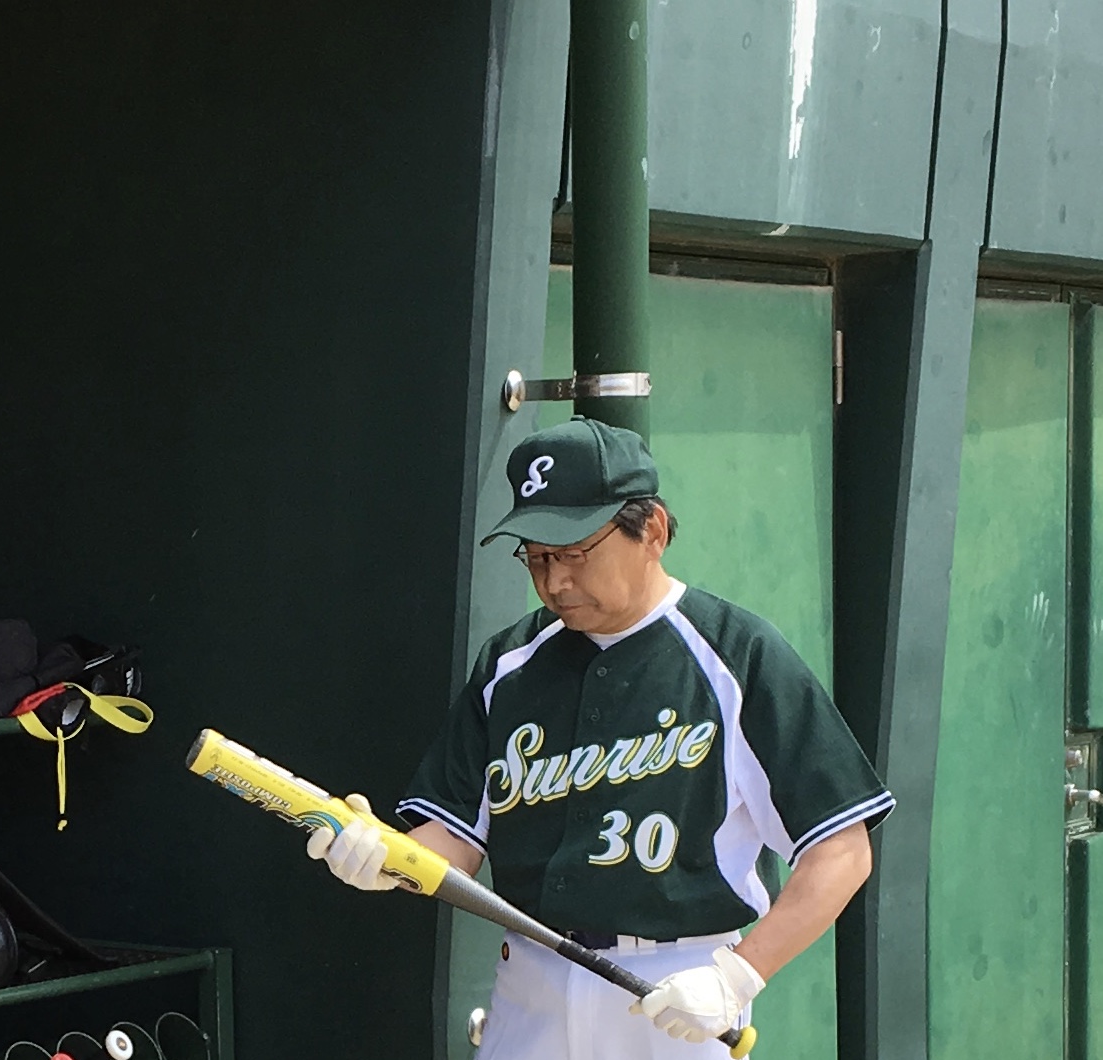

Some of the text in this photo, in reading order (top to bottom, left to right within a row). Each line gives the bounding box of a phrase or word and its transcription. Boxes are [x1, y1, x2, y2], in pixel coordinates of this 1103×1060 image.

[521, 456, 554, 497] S
[212, 764, 292, 810] COMPOSITE
[486, 707, 718, 814] Sunrise
[588, 810, 679, 873] 30
